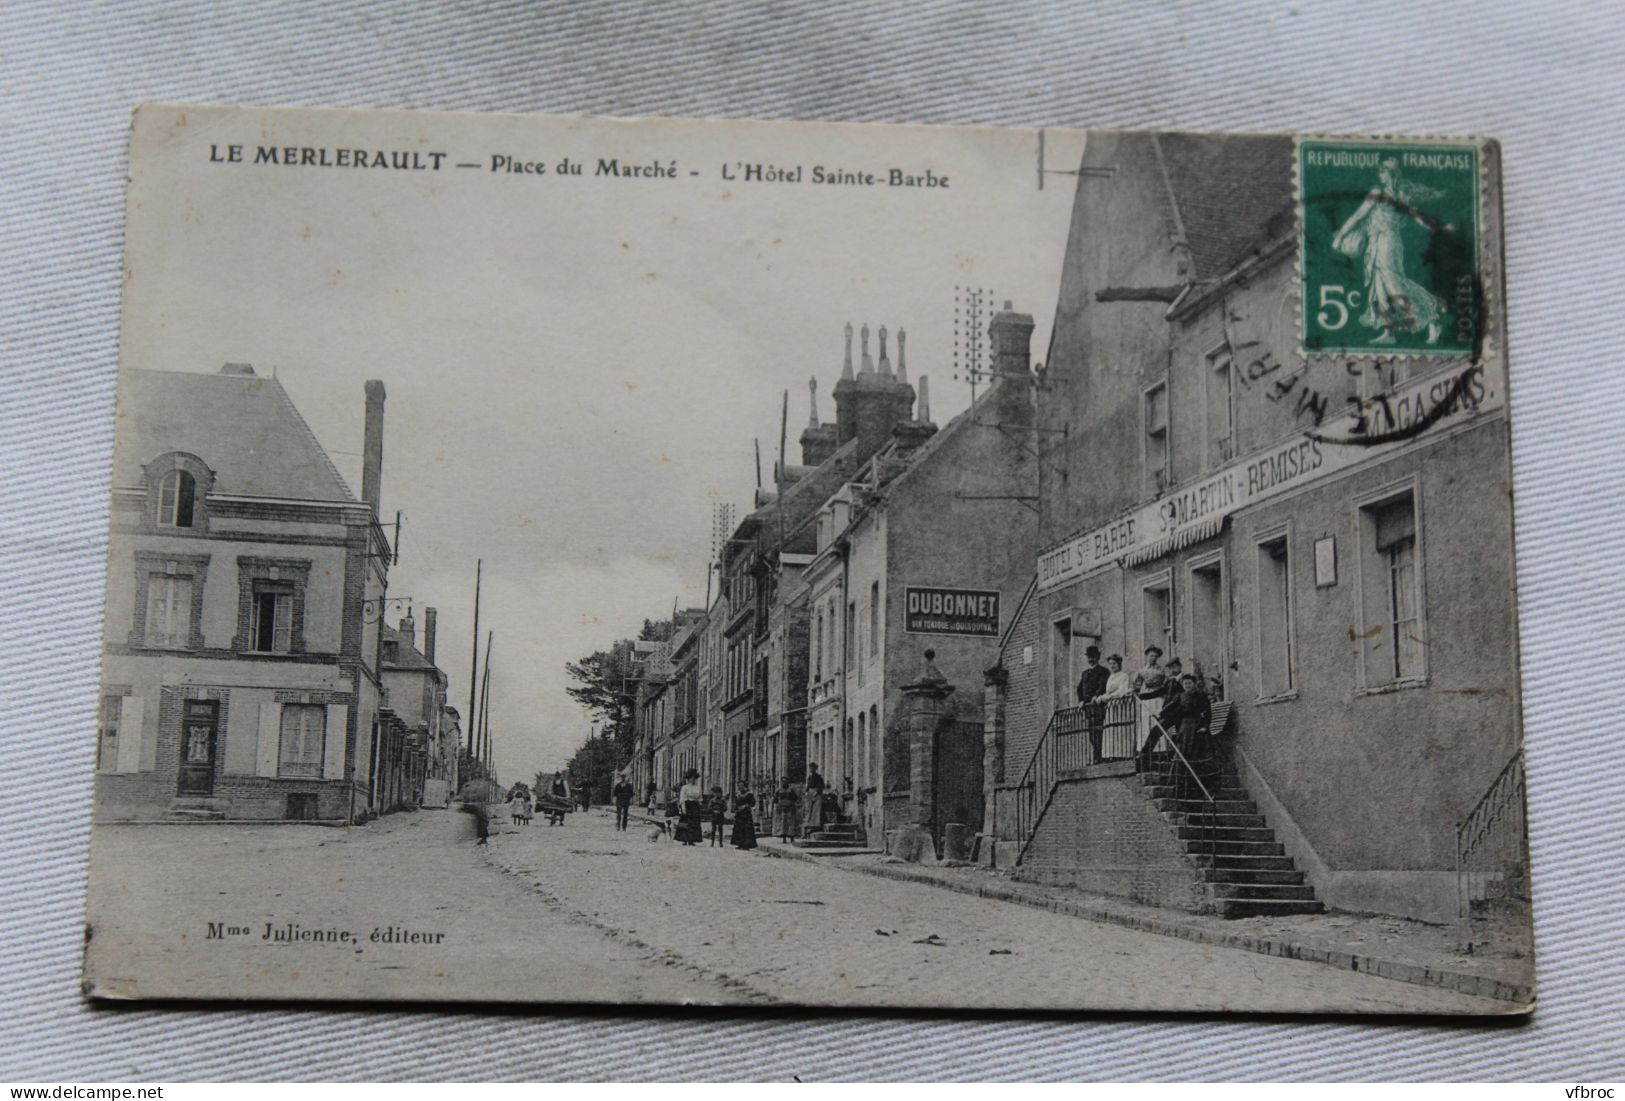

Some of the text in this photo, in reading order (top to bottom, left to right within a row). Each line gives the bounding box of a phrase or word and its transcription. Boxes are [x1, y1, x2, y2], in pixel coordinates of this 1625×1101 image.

[209, 145, 950, 188] LE MERLERAULT Place du Marché L'Hôtel Sainte-Barbe
[1403, 152, 1470, 171] FRANÇAISE
[1456, 273, 1473, 344] POSTES
[1042, 546, 1073, 583] HOTEL
[1095, 519, 1135, 561] BARBE
[1178, 473, 1234, 526] MARTIN
[1247, 439, 1323, 496] REMISES
[908, 592, 996, 617] DUBONNET
[261, 923, 358, 945] Julienne,
[370, 927, 446, 945] éditeur
